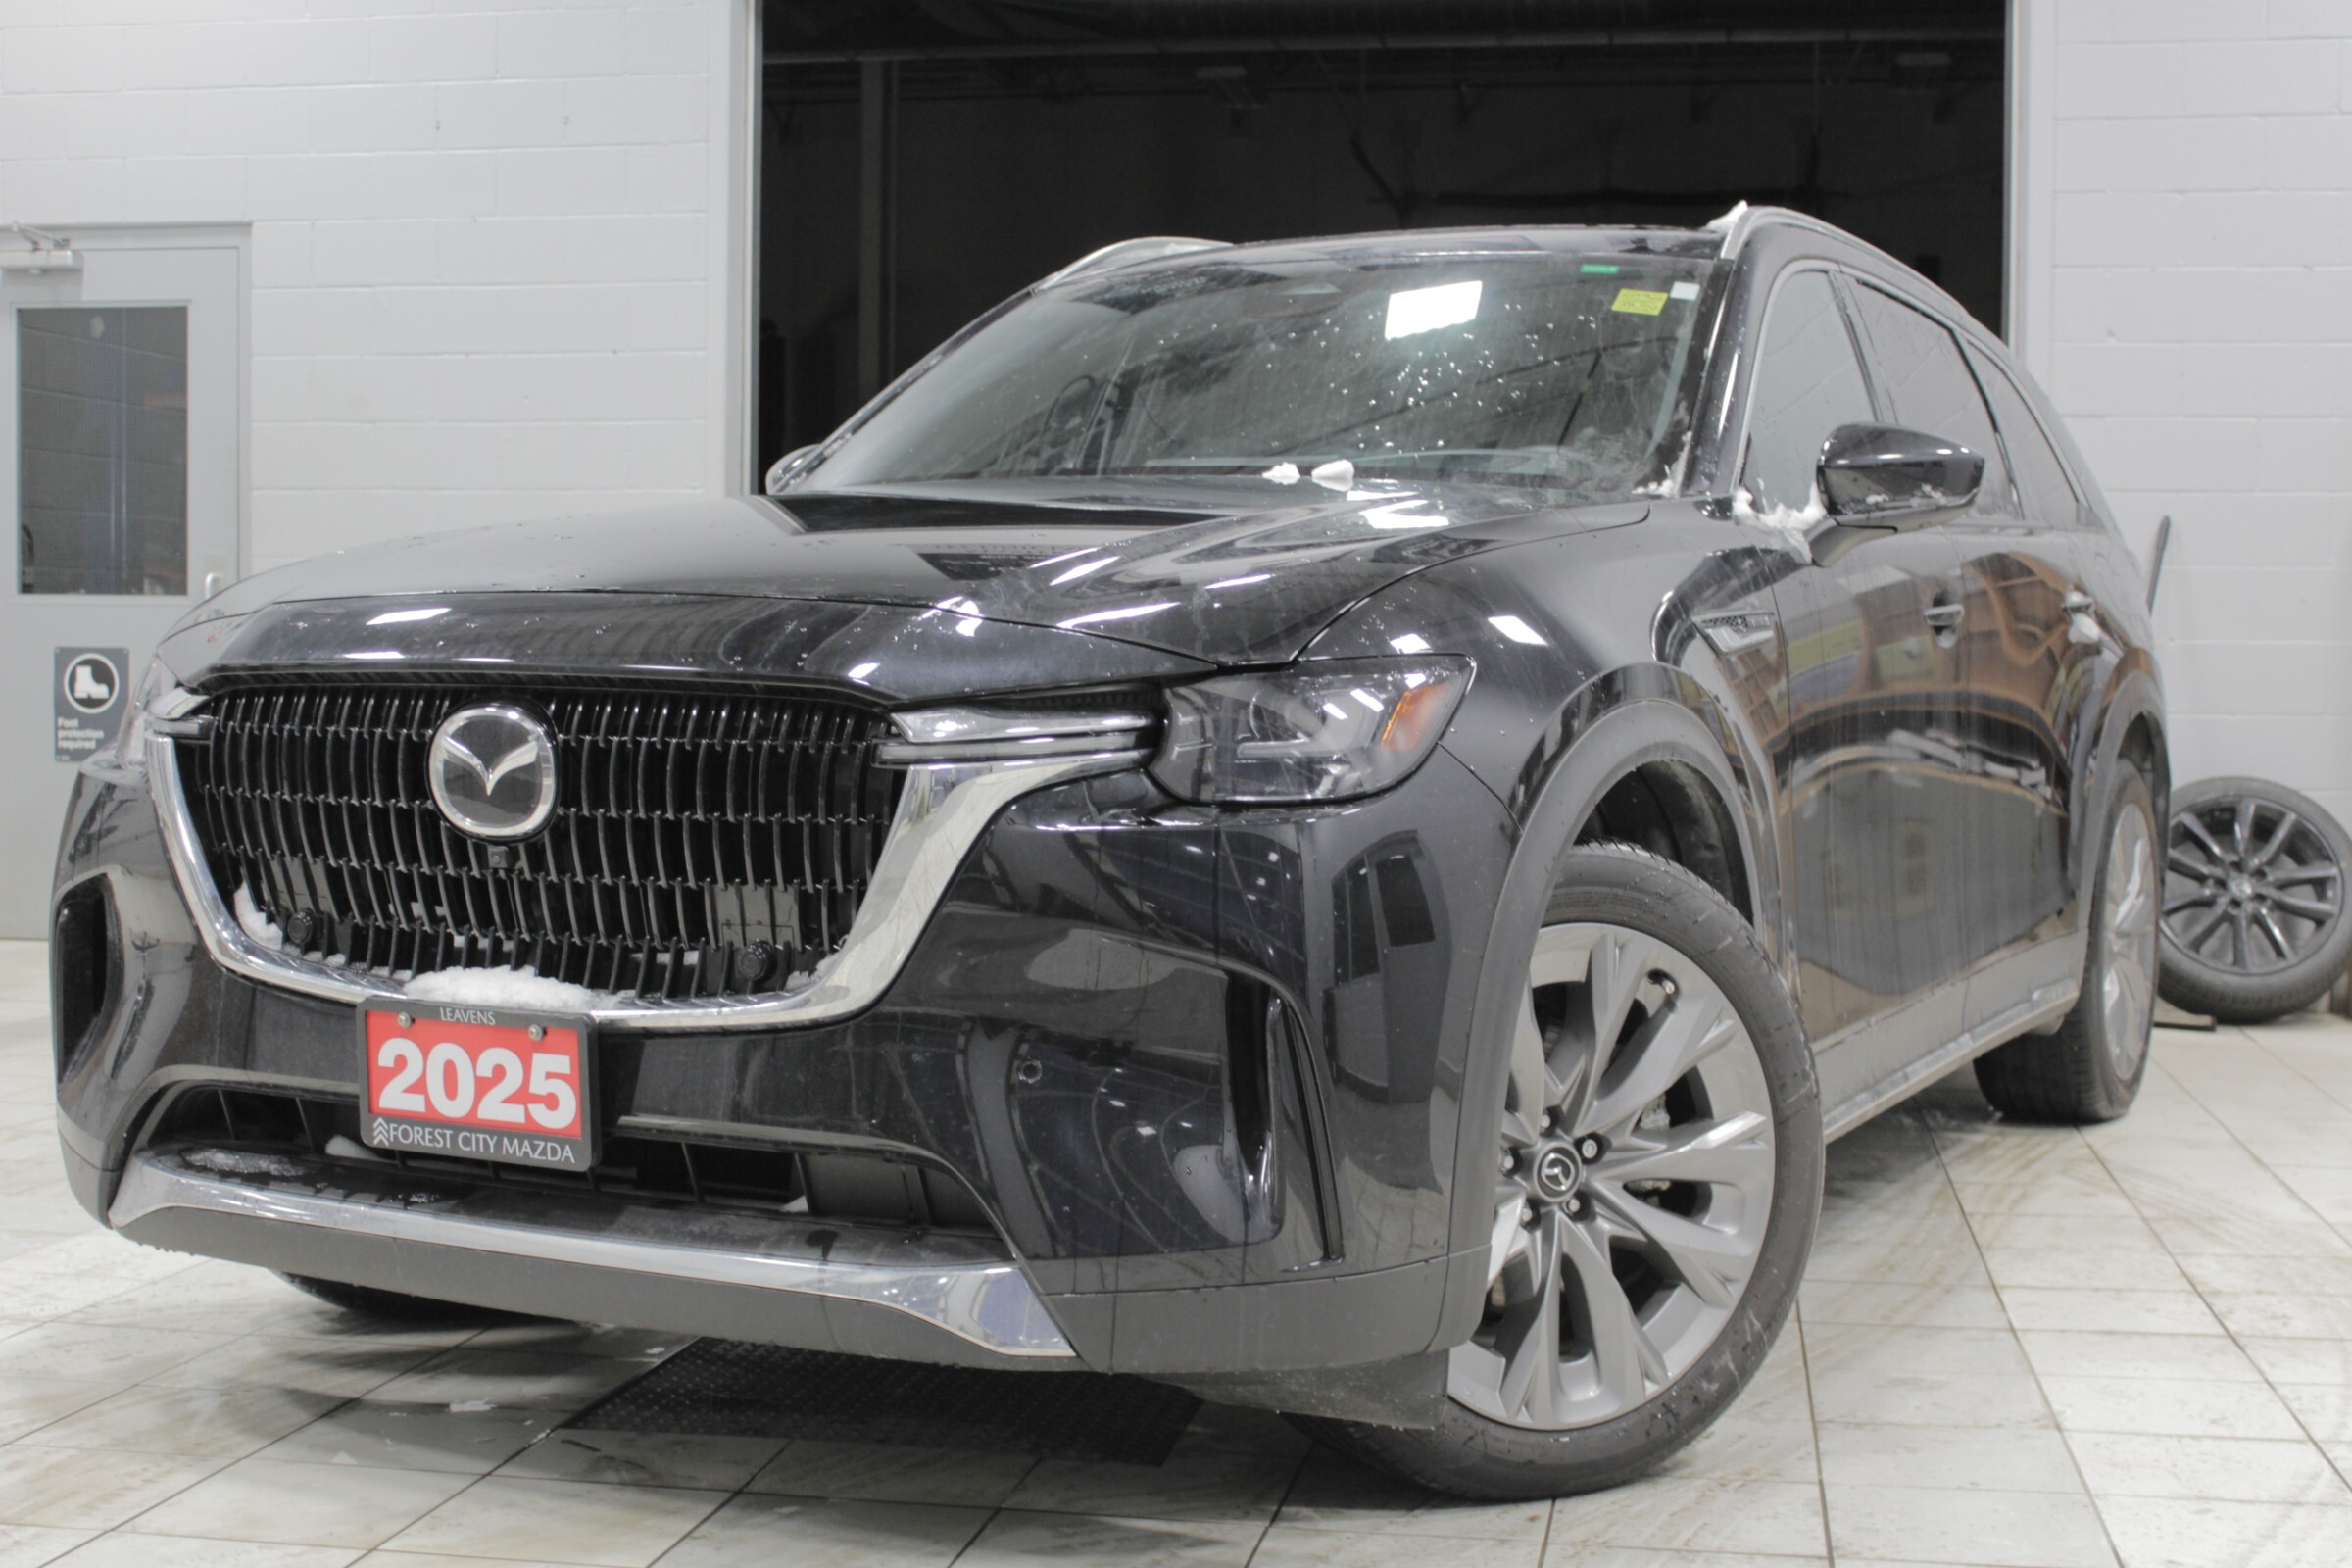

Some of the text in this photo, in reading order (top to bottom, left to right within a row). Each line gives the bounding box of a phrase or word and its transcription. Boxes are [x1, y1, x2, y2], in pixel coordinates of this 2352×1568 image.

[440, 1007, 496, 1026] LEAVENS
[377, 1037, 577, 1129] 2025
[390, 1123, 576, 1164] FOREST CITY MAZDA
